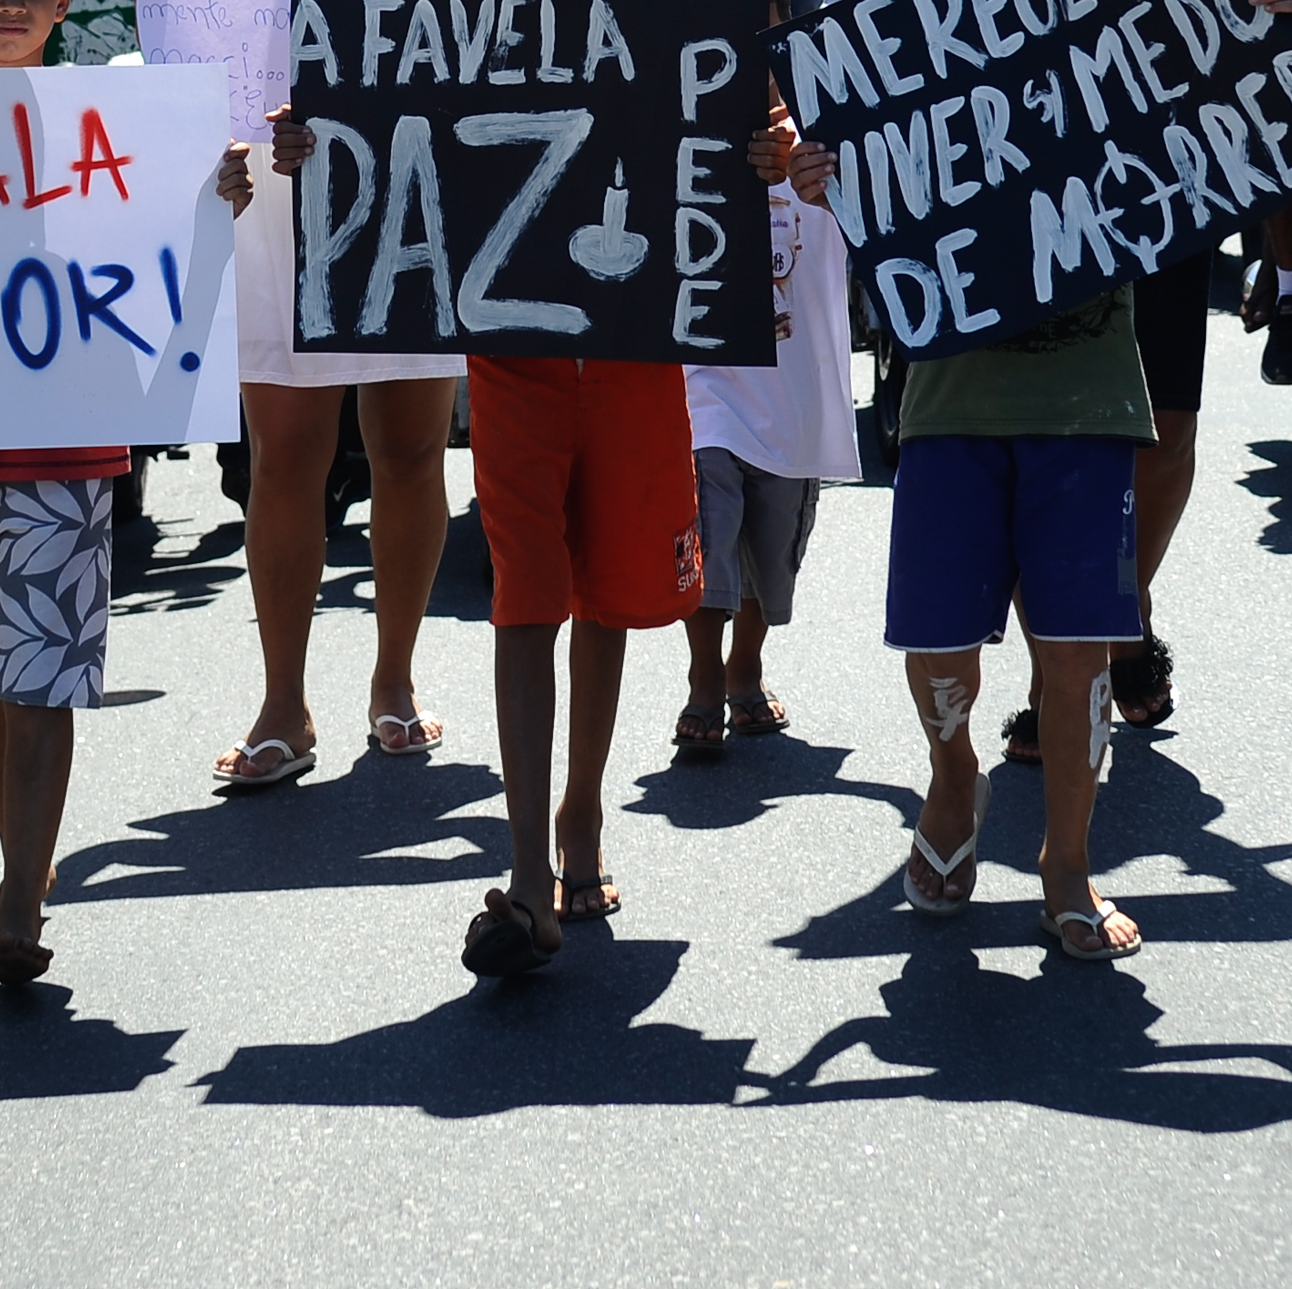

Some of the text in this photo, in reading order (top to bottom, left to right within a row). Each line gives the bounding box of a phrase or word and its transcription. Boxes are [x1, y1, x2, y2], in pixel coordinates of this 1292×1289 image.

[298, 108, 595, 342] PAZ
[672, 38, 738, 349] PEDE
[825, 85, 1030, 248] VIVER
[873, 229, 1001, 349] DE
